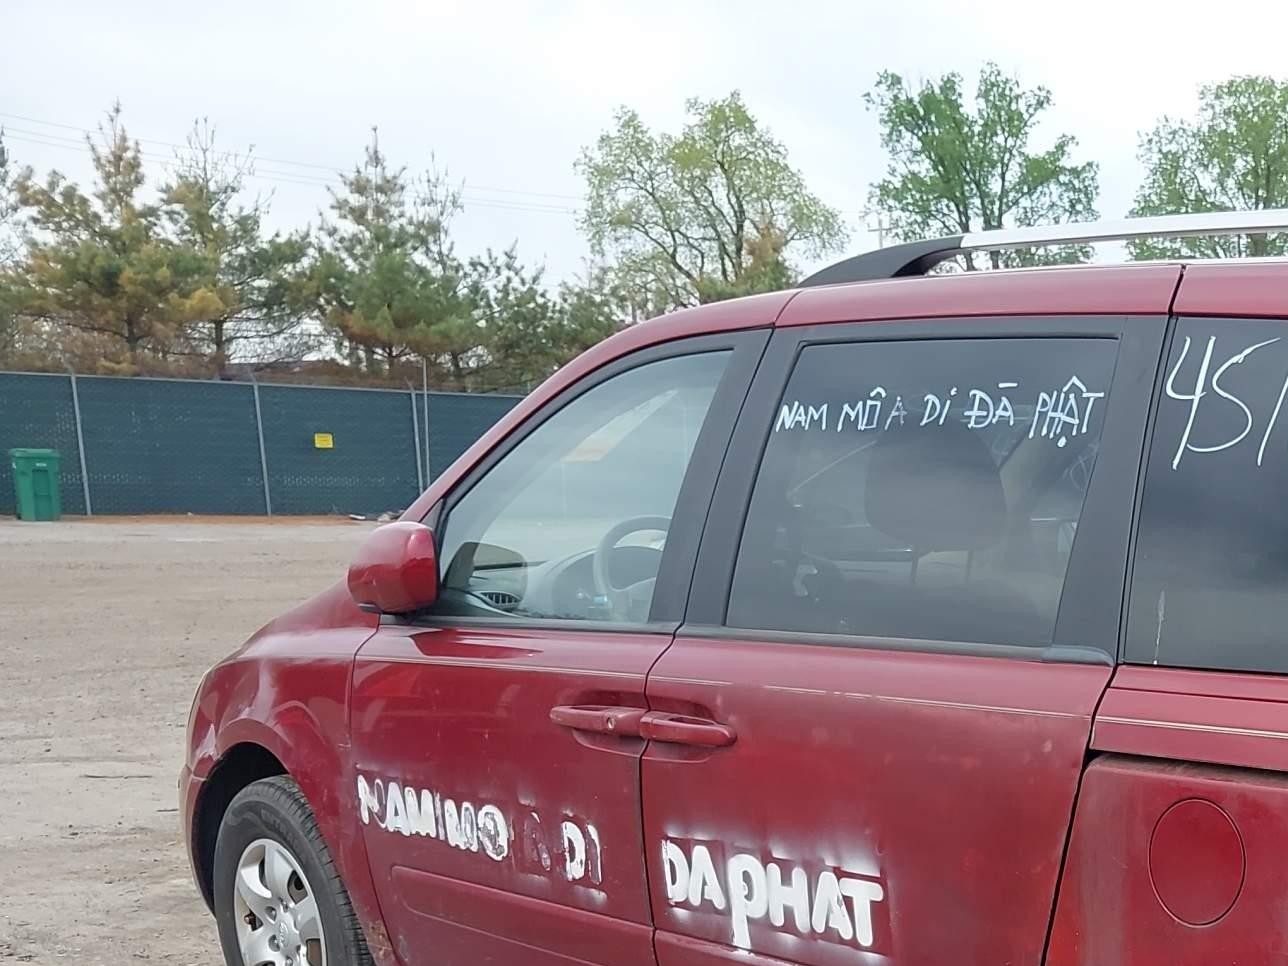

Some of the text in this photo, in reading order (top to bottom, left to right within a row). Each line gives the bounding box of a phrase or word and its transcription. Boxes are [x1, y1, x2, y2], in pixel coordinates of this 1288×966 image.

[775, 400, 828, 433] NAM
[837, 386, 887, 433] MÔ
[1028, 376, 1106, 448] PHẬT
